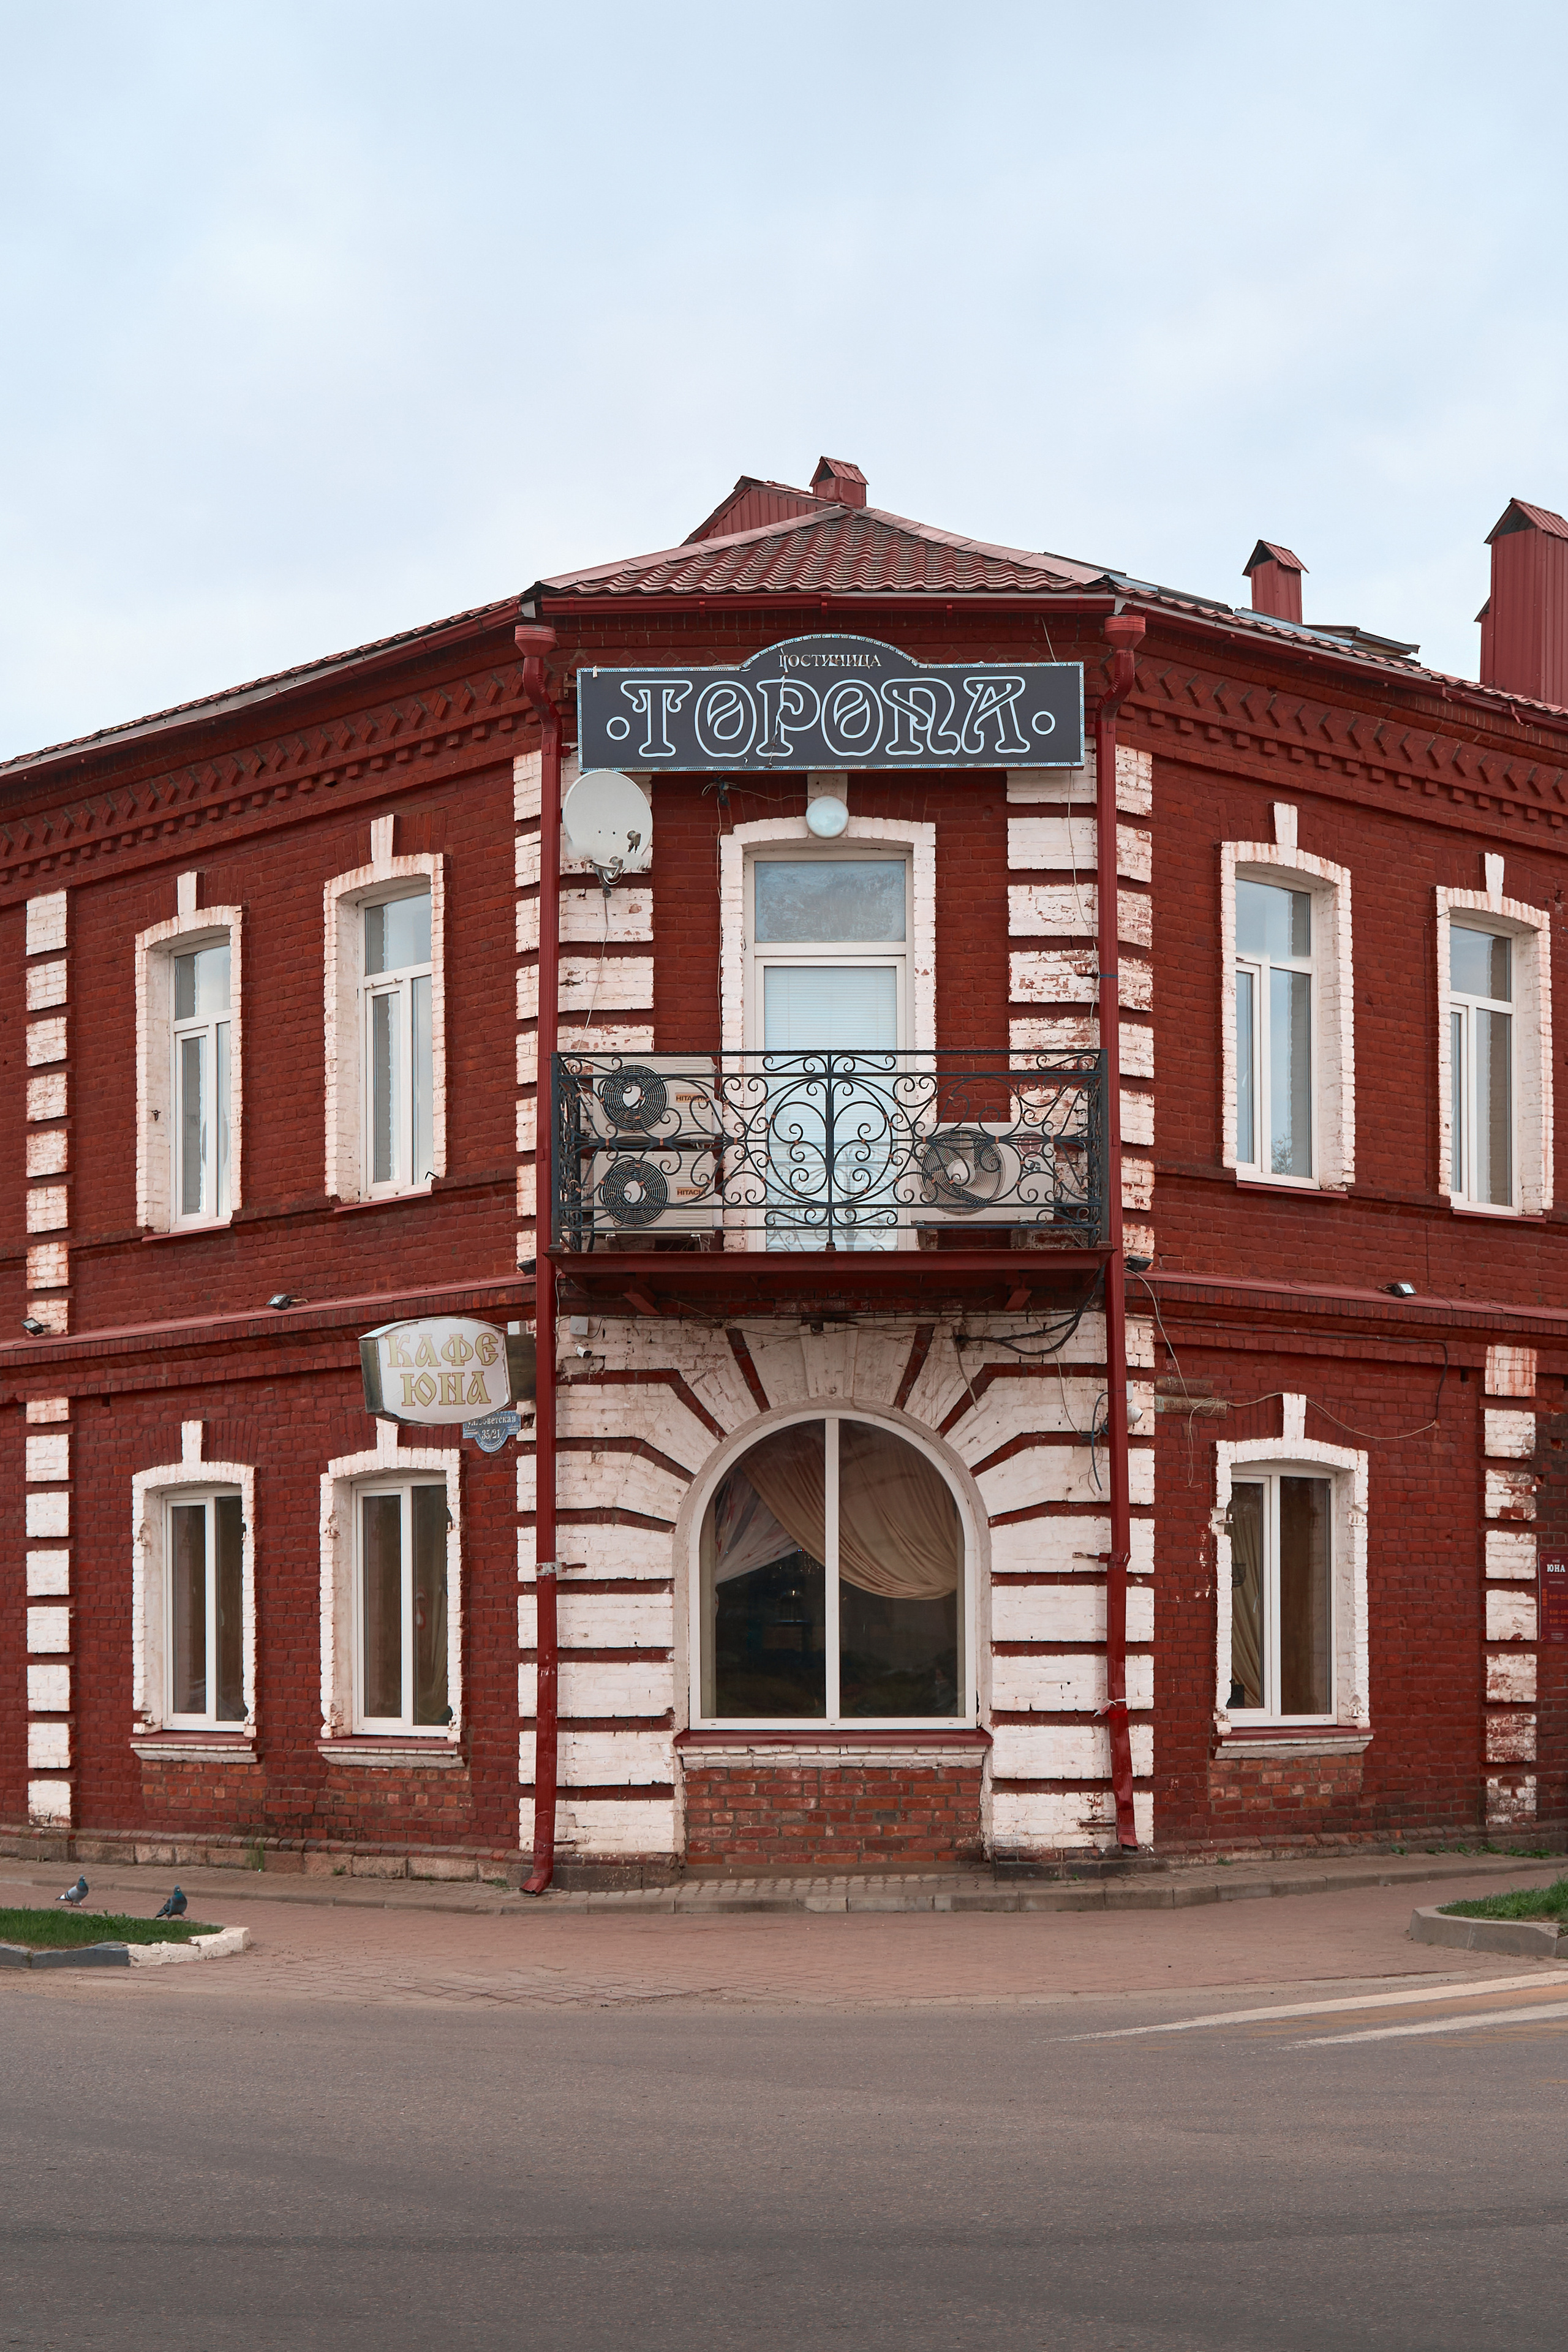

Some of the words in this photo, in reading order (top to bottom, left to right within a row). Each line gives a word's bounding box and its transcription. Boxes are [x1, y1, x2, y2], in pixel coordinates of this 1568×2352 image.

[778, 654, 882, 669] ГОСТИНИЦА
[620, 676, 1030, 757] ТОРОПА
[385, 1333, 499, 1368] КАФЕ
[400, 1371, 492, 1407] ЮНА
[481, 1428, 500, 1441] 35/21
[1547, 1564, 1566, 1572] ЮНА
